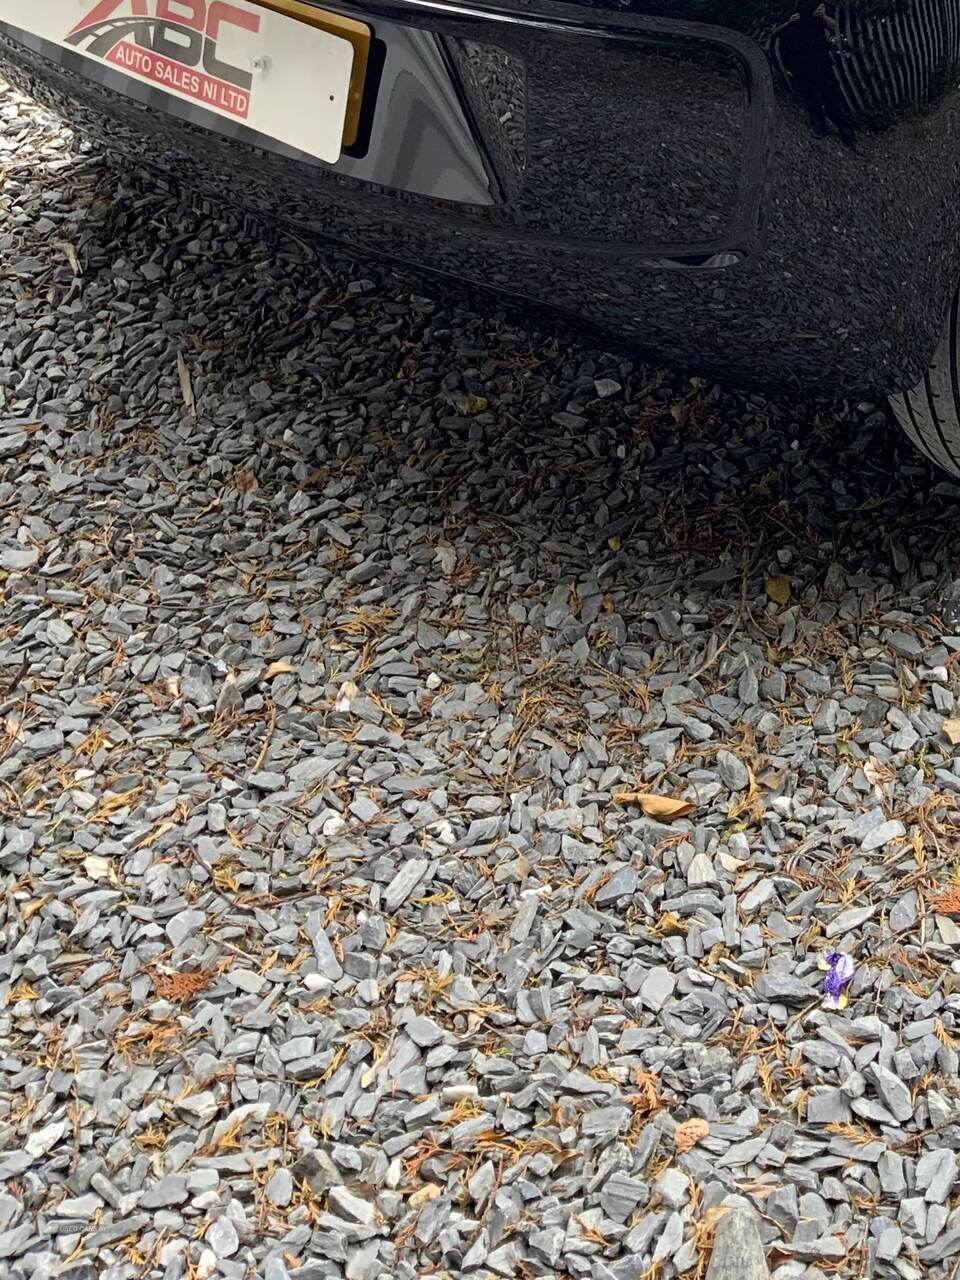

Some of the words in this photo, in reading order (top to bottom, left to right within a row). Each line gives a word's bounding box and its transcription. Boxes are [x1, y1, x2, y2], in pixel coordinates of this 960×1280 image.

[115, 45, 152, 73] AUTO
[155, 61, 199, 93] SALES
[203, 80, 216, 100] NI
[220, 87, 247, 112] LTD
